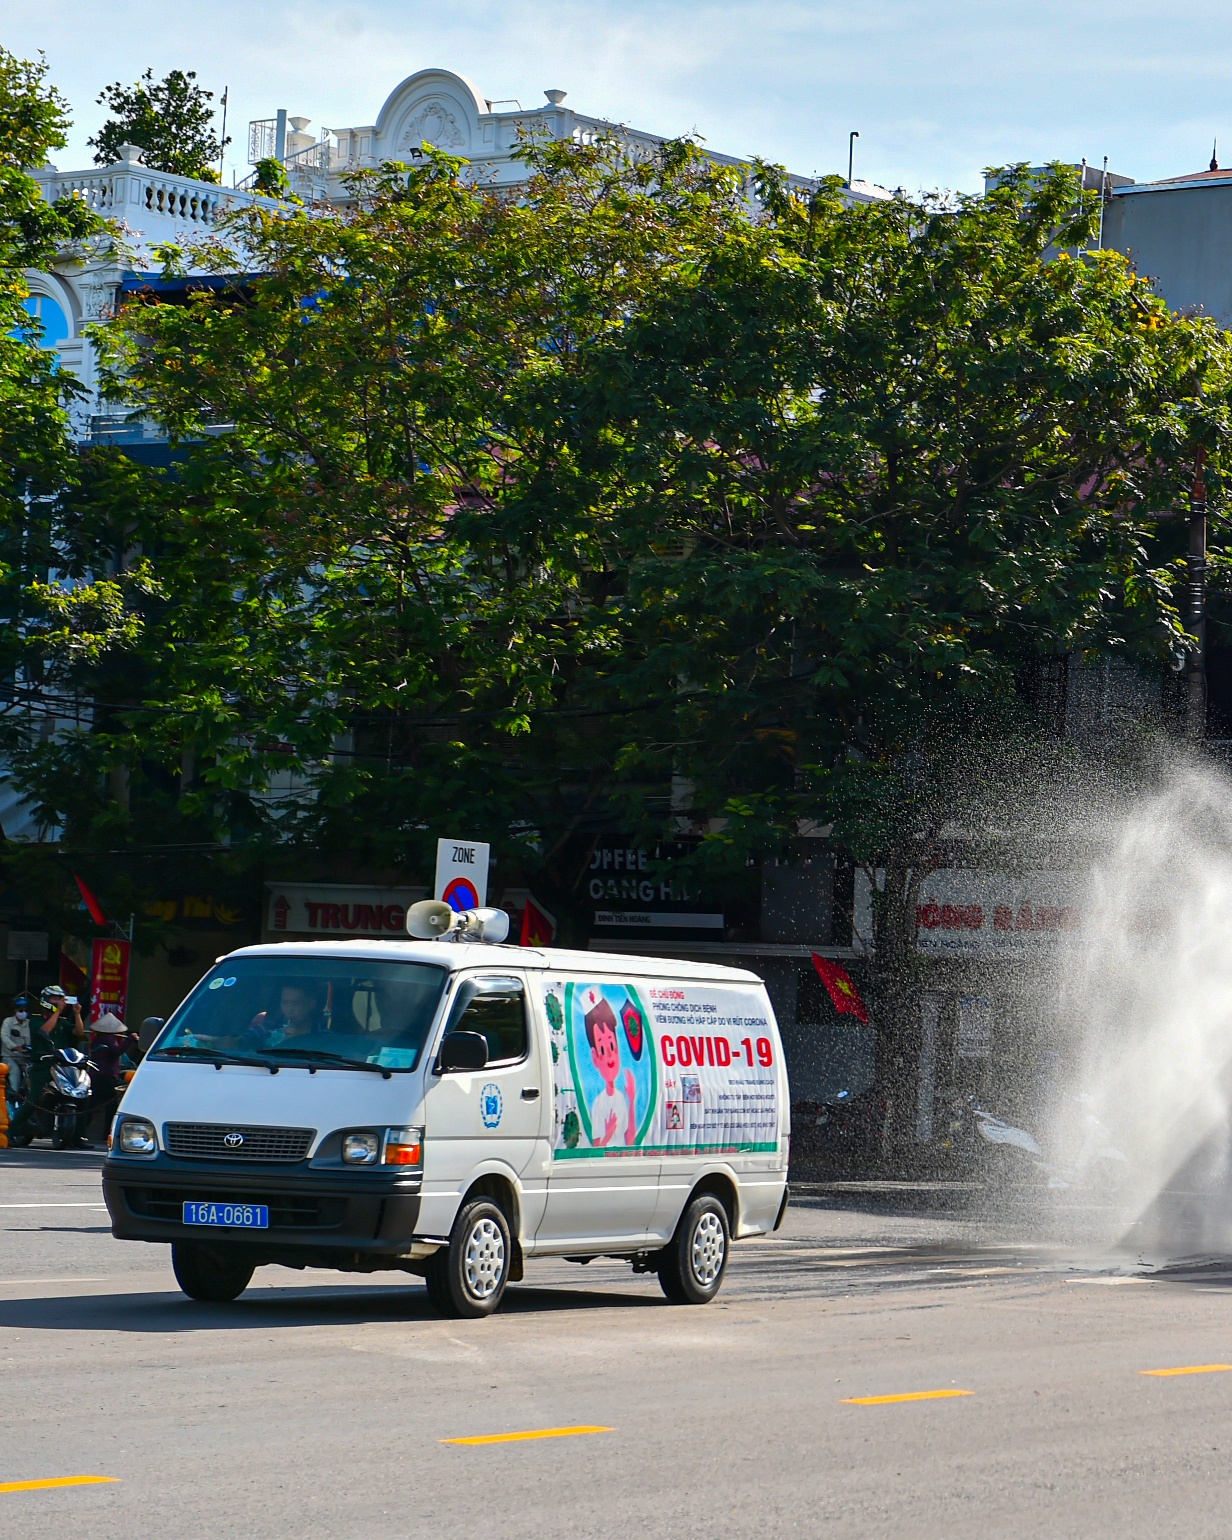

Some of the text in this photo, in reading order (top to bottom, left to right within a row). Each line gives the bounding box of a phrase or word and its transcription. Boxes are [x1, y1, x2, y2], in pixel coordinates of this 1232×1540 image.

[452, 846, 476, 865] ZONE
[589, 849, 648, 870] OFFEE
[304, 902, 404, 931] TRUNG
[744, 1017, 768, 1026] CORONA
[660, 1034, 773, 1068] COVID-19
[190, 1204, 261, 1226] 16A-0661
